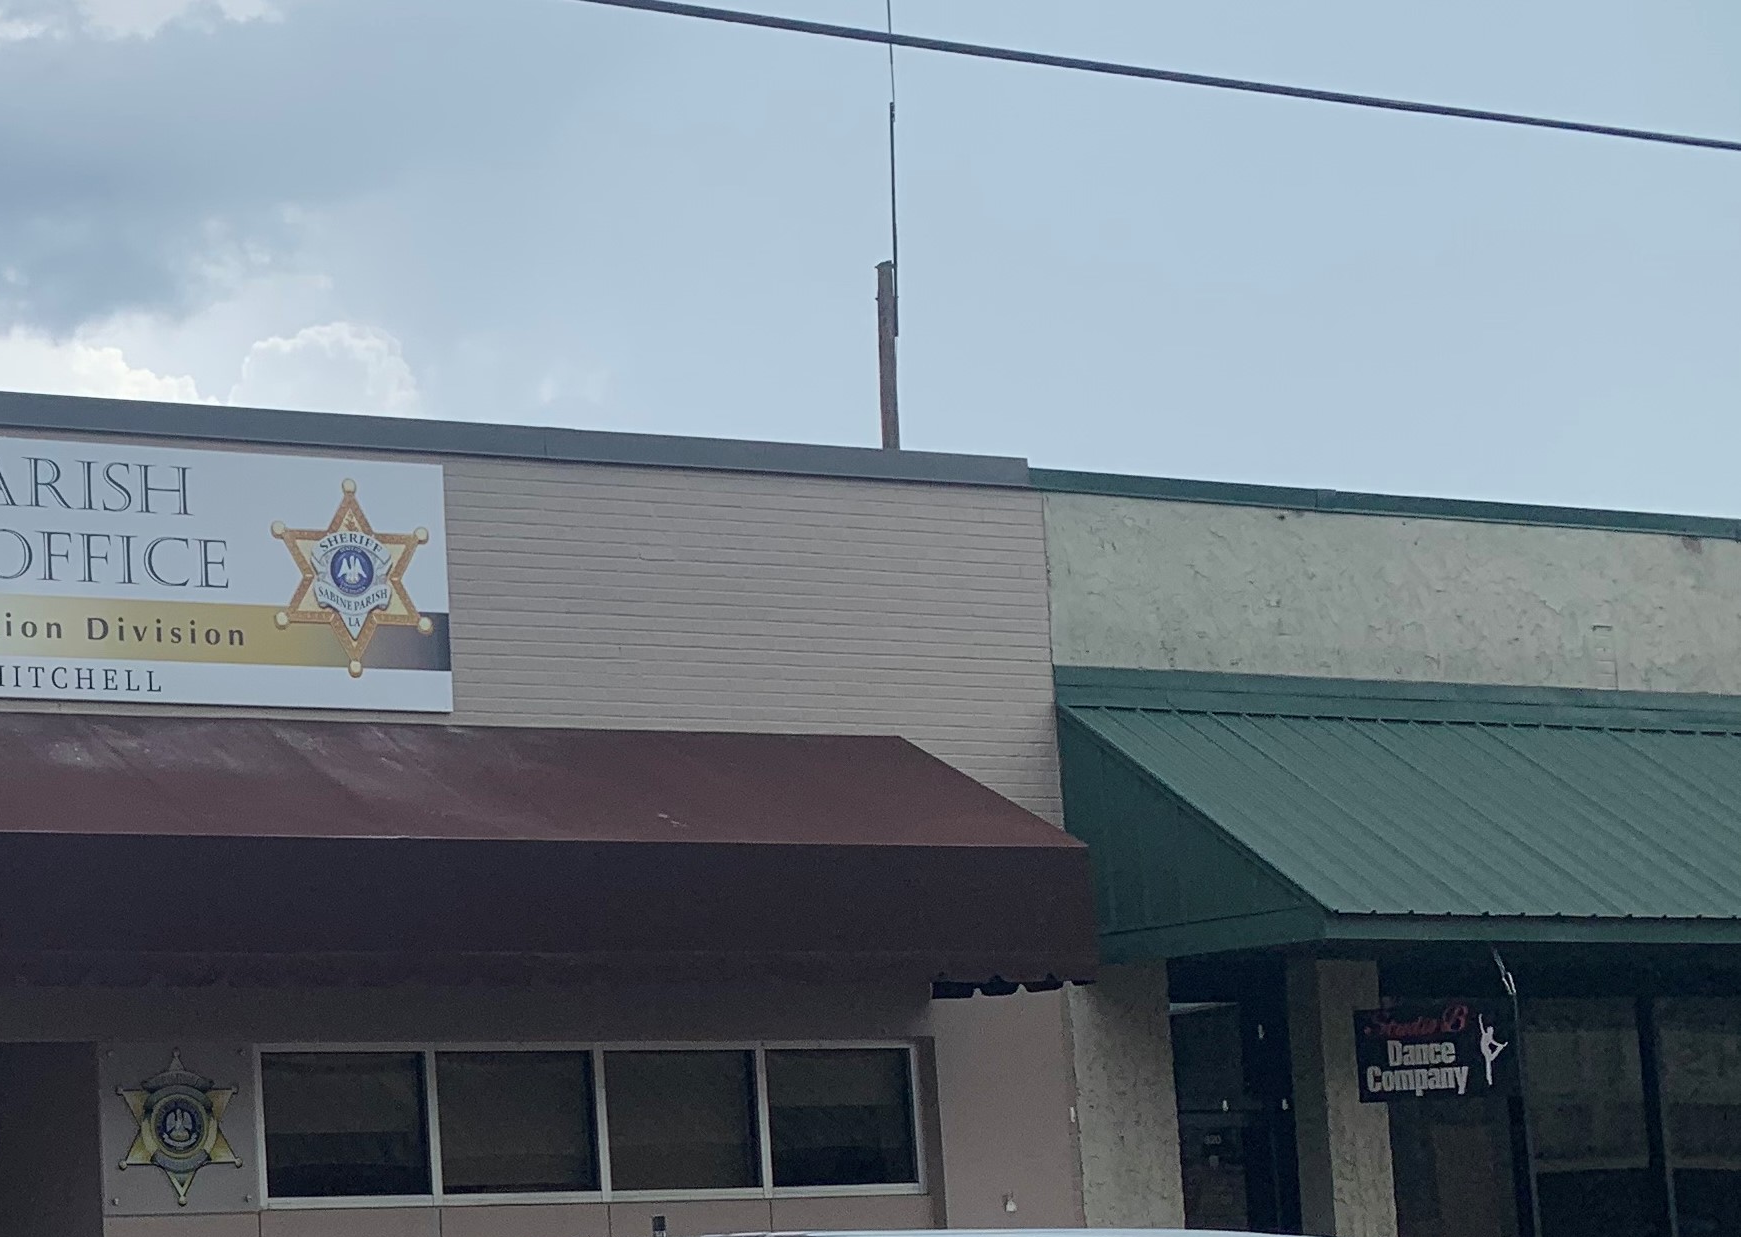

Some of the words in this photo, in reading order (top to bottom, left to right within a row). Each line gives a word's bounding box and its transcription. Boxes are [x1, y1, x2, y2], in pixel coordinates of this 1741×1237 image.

[319, 533, 383, 553] SHERIFF
[318, 586, 353, 611] SABINE
[354, 588, 388, 611] PARISH
[87, 617, 245, 646] Division
[348, 617, 361, 627] LA
[1387, 1040, 1456, 1067] Dance
[1367, 1065, 1469, 1096] Company
